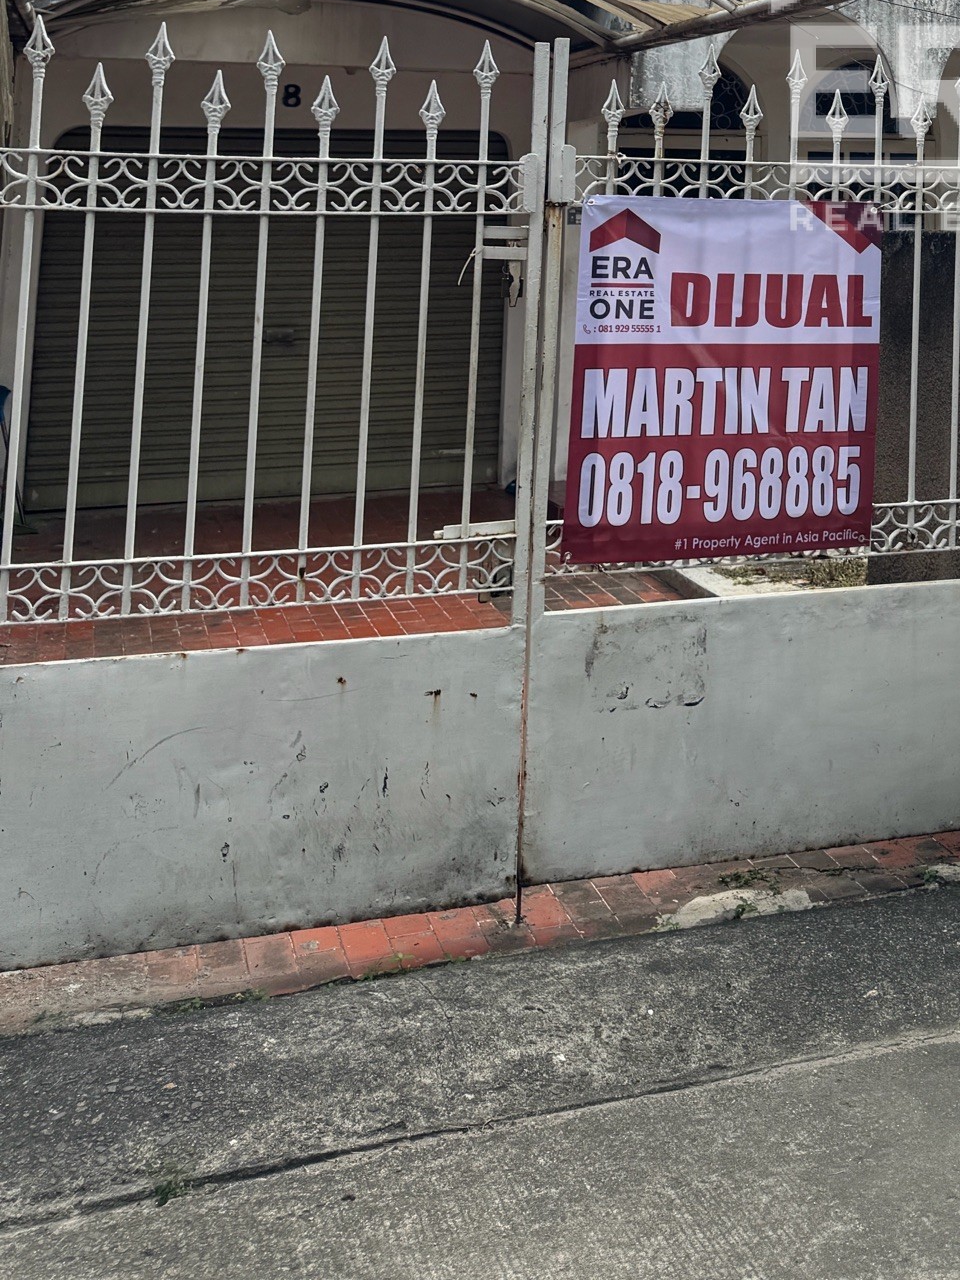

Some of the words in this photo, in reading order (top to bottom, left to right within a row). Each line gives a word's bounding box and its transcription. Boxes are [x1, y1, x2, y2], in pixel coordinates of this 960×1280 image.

[283, 84, 301, 107] 8
[591, 256, 654, 279] ERA
[589, 298, 655, 320] ONE
[670, 272, 872, 328] DIJUAL
[598, 324, 613, 333] 081
[615, 324, 630, 333] 929
[632, 324, 654, 333] 55555
[656, 324, 661, 333] 1
[580, 366, 771, 439] MARTIN
[780, 366, 870, 433] TAN
[576, 444, 861, 528] 0818-968885
[674, 538, 688, 550] #1
[692, 535, 741, 551] Property
[744, 534, 780, 549] Agent
[782, 532, 792, 545] in
[795, 531, 819, 543] Asia
[822, 528, 859, 542] Pacific
